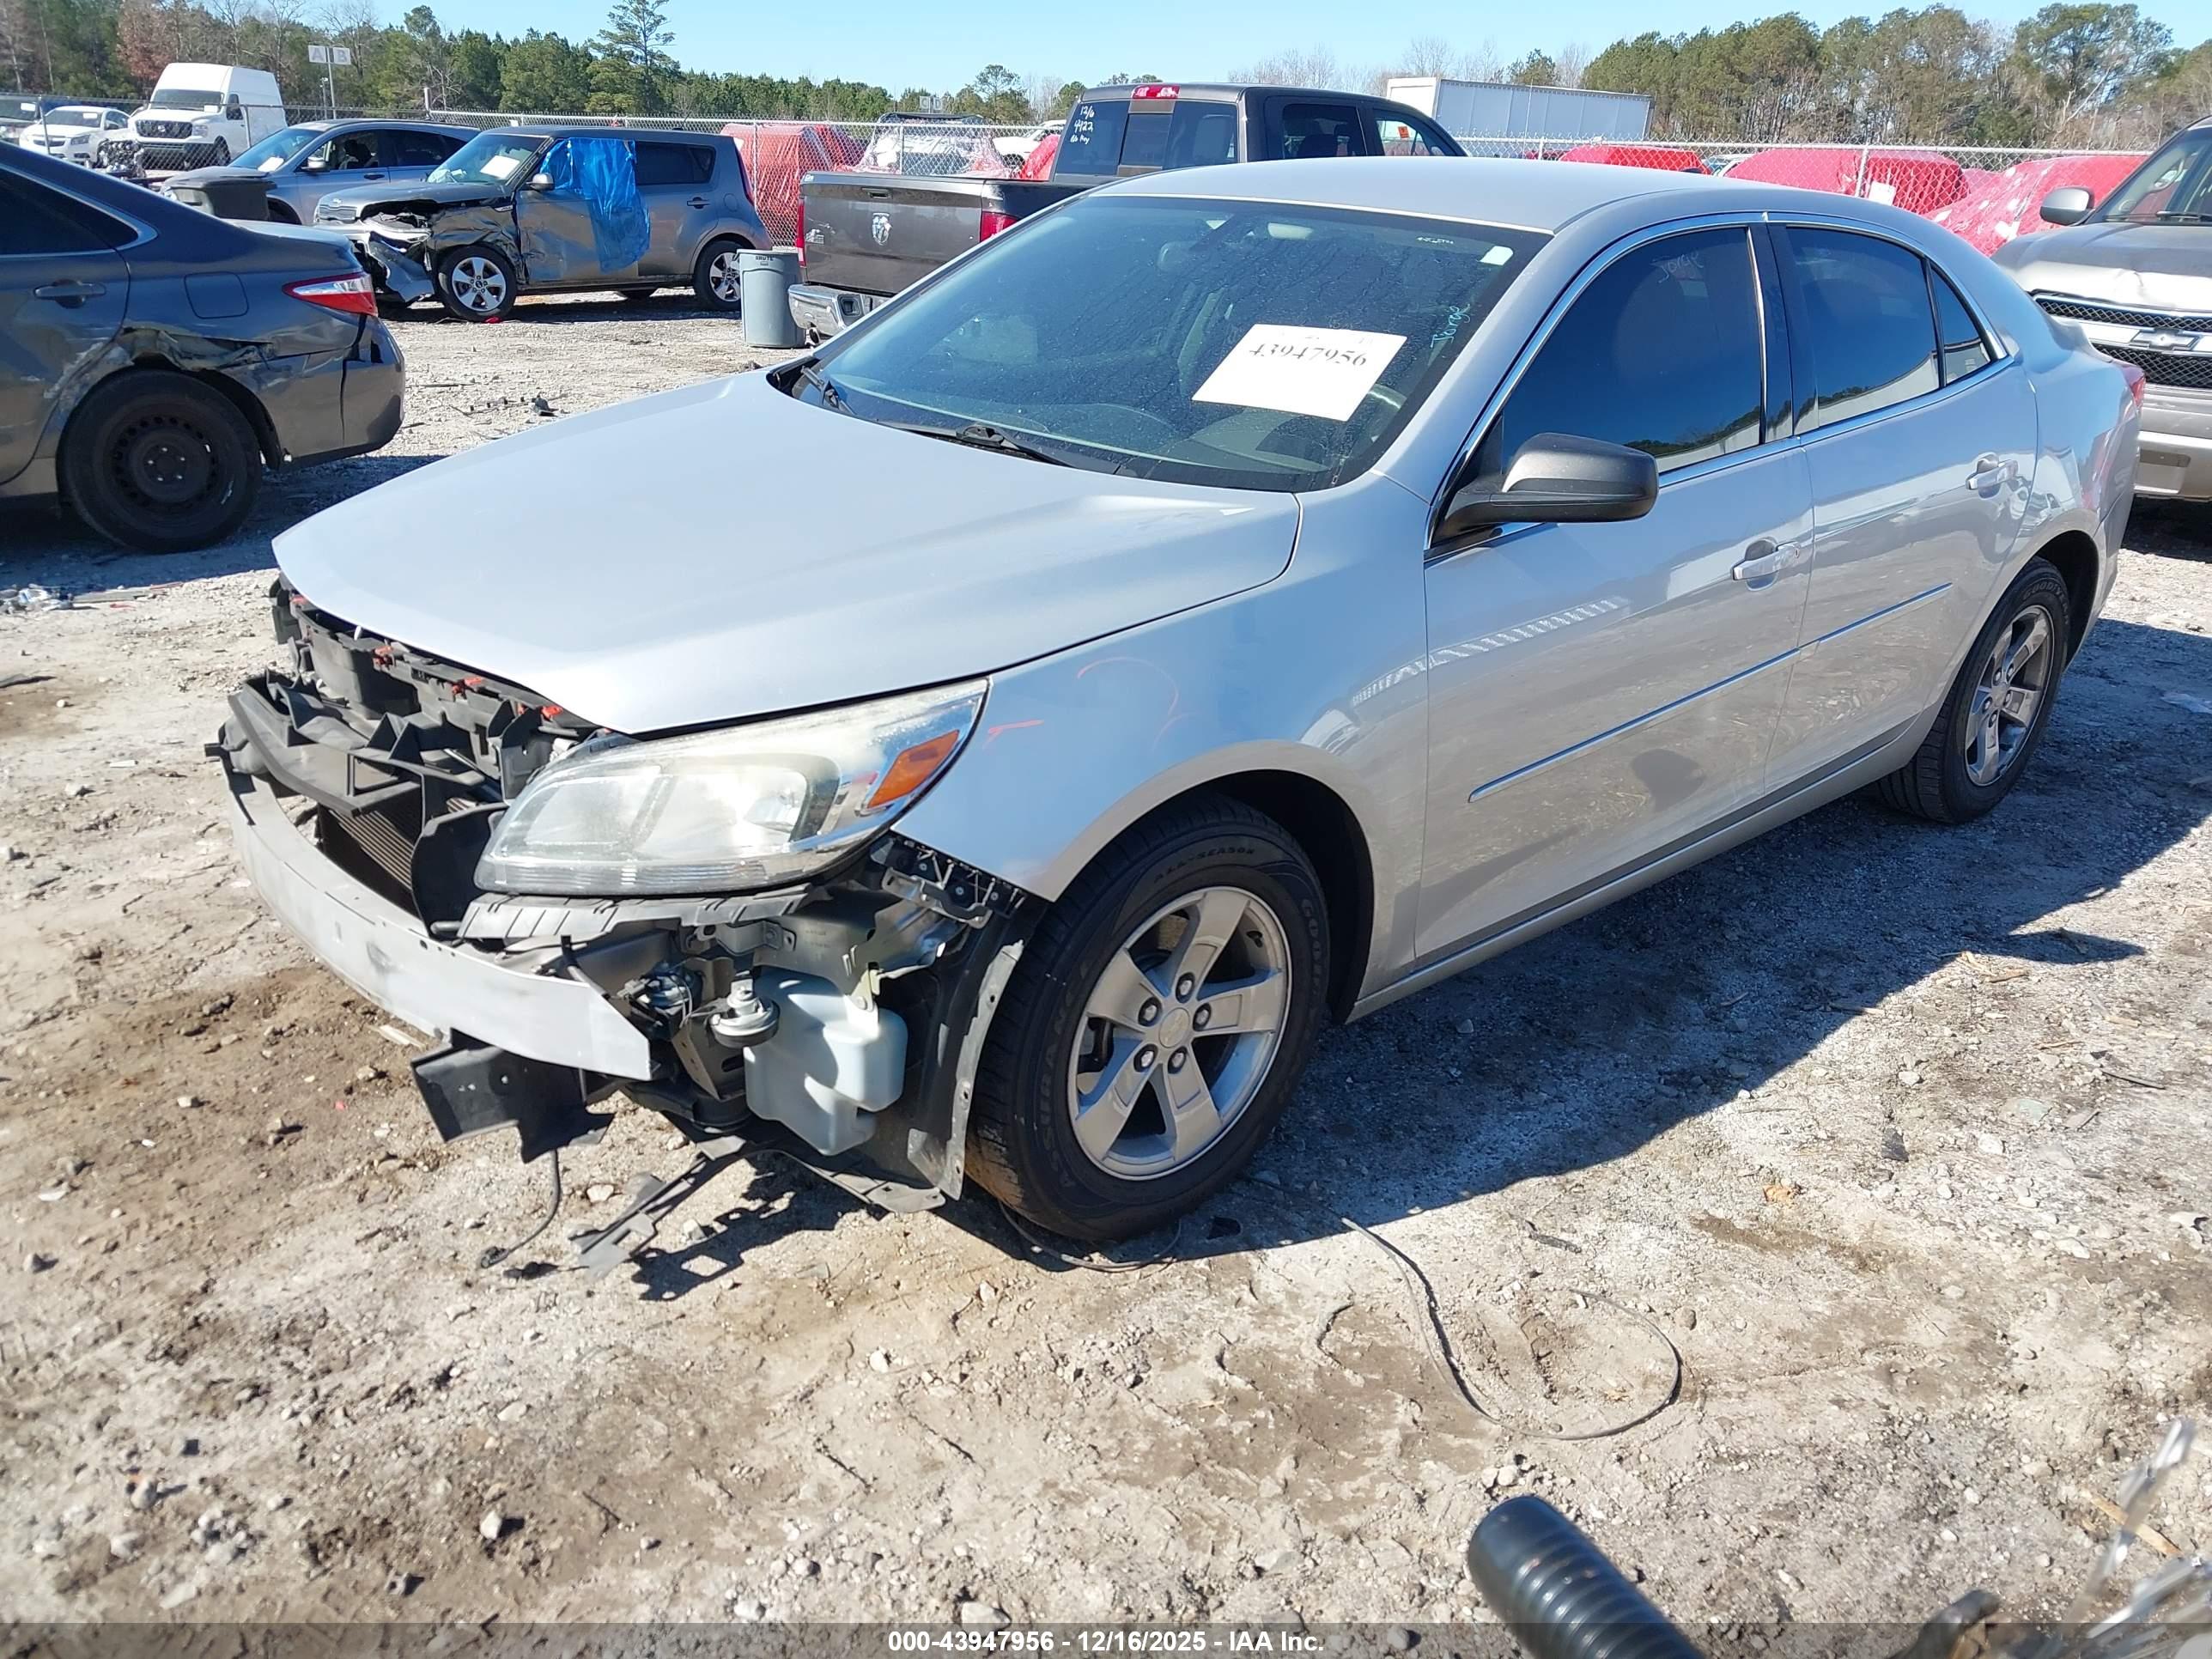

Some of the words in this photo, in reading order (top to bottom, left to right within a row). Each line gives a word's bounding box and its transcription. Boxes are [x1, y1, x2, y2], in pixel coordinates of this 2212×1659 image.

[1430, 303, 1471, 349] Jorge
[1249, 343, 1367, 367] 43947956
[2022, 580, 2069, 626] GOODY
